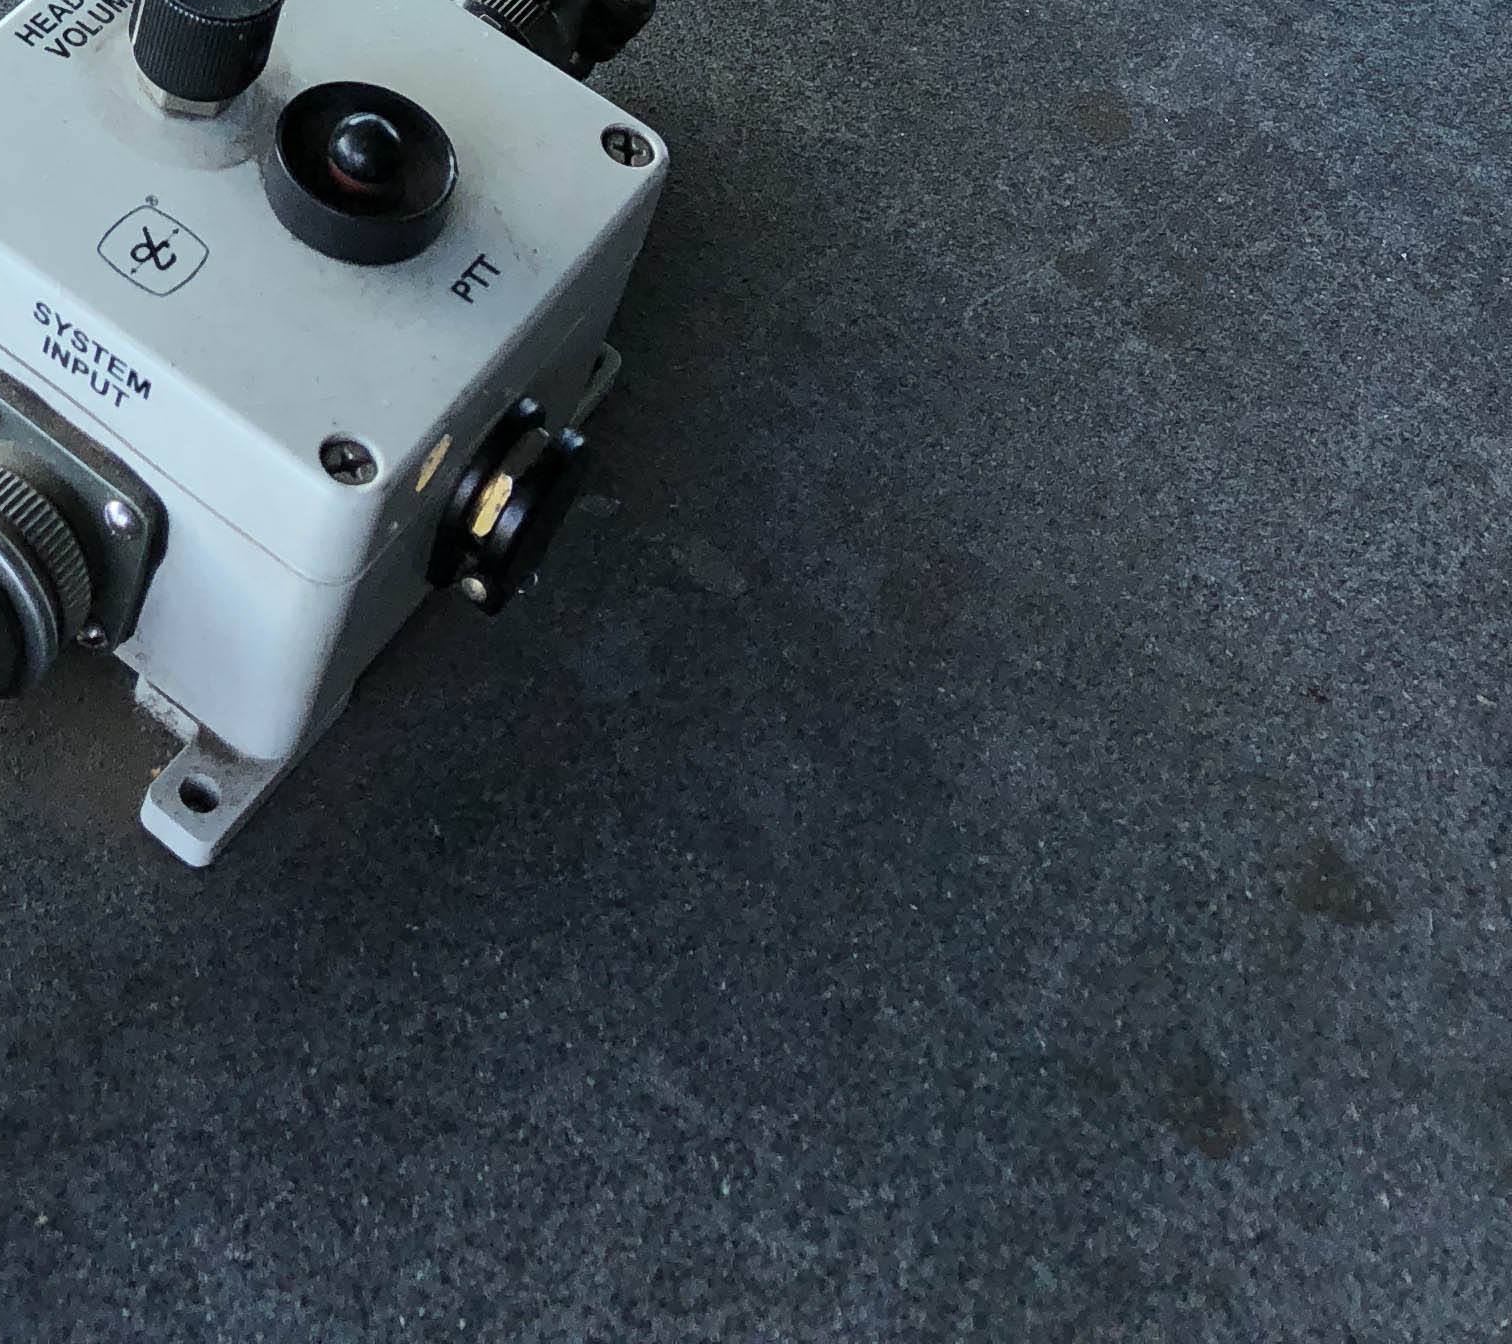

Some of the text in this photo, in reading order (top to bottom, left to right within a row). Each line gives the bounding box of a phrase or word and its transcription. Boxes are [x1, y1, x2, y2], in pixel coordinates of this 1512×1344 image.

[450, 253, 501, 305] PTT
[33, 300, 153, 400] SYSTEM
[43, 335, 130, 408] INPUT
